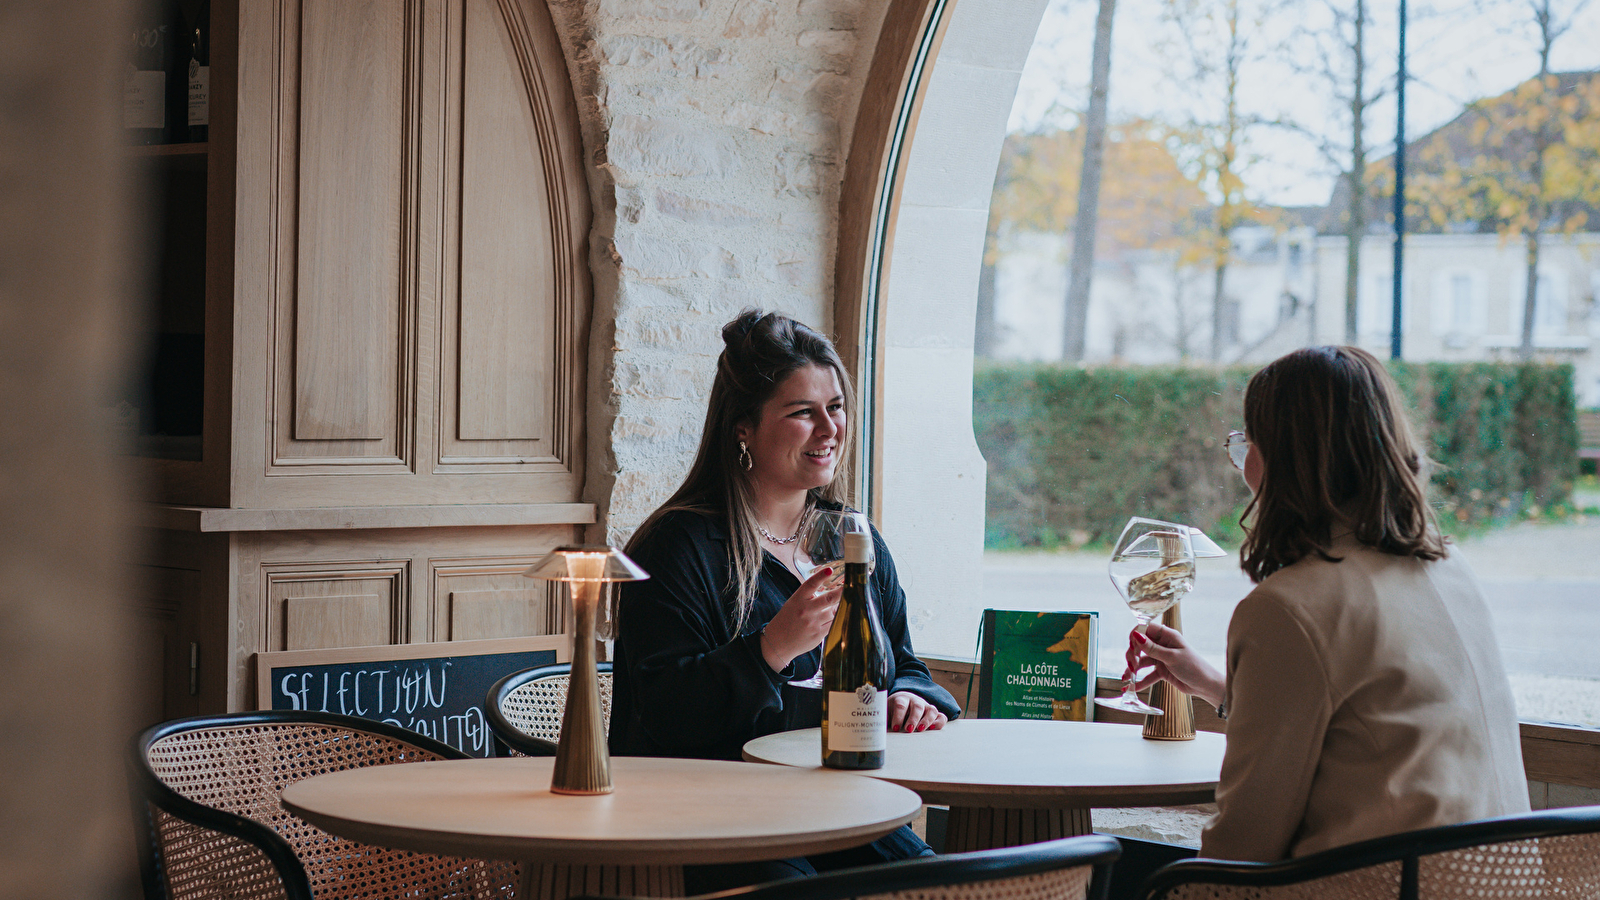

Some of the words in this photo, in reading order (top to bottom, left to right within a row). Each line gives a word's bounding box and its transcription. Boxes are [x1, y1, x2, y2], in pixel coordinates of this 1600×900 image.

[1020, 663, 1032, 674] LA
[1034, 662, 1059, 676] CÔTE
[1006, 675, 1072, 688] CHALONNAISE
[280, 664, 448, 716] SELECTION
